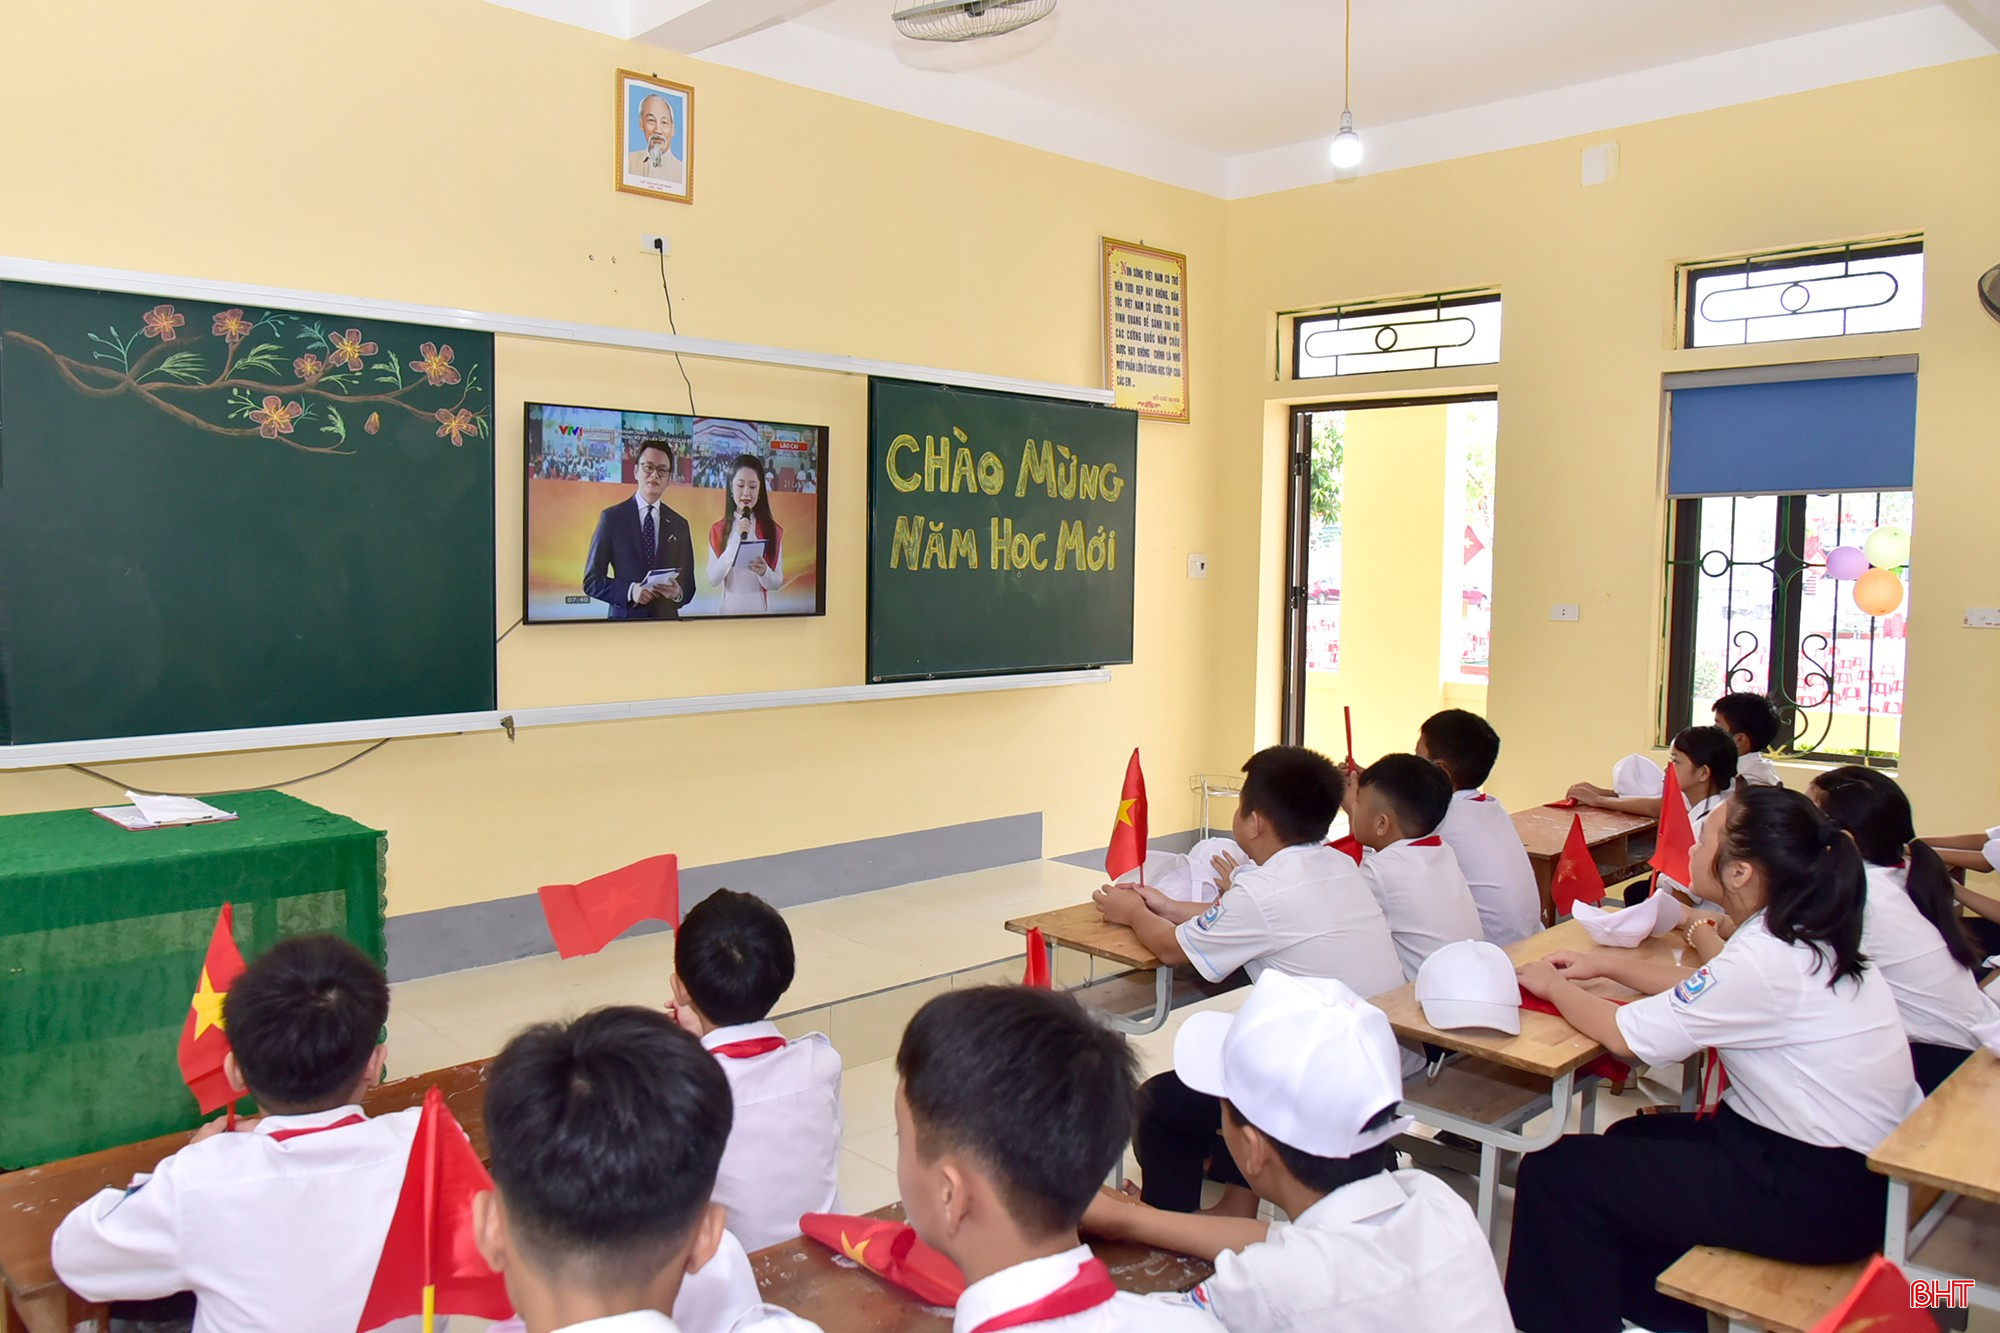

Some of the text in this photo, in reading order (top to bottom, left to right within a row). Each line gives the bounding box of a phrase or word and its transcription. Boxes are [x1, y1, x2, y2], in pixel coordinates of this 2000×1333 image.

[1155, 272, 1163, 282] NAM
[1135, 300, 1143, 310] NAM
[886, 426, 1005, 495] CHÀO
[890, 515, 978, 571] NĂM
